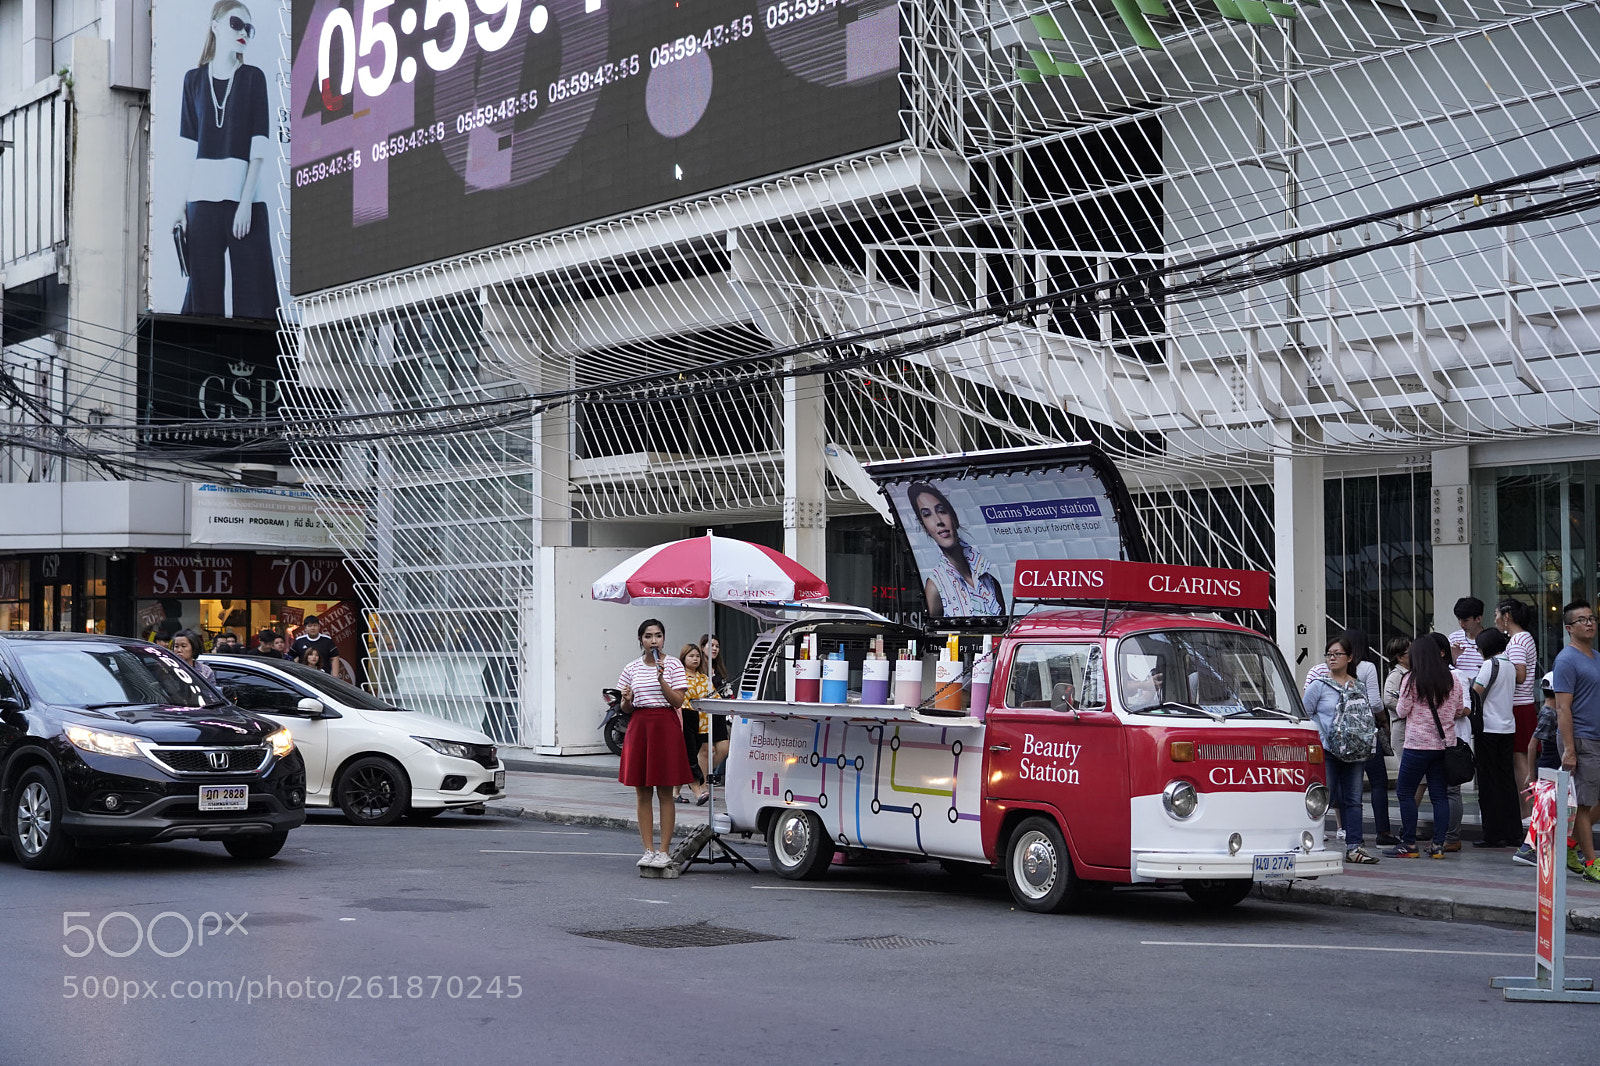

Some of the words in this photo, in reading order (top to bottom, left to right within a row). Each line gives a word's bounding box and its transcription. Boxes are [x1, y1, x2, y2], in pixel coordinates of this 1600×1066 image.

[198, 375, 282, 422] GSP
[985, 507, 1022, 520] Clarins
[1022, 504, 1058, 518] Beauty
[1058, 501, 1097, 515] station
[213, 516, 244, 524] ENGLISH
[249, 517, 285, 526] PROGRAM
[993, 526, 1013, 535] Meet
[1014, 526, 1023, 534] us
[1024, 525, 1032, 534] at
[1034, 525, 1049, 534] your
[1051, 521, 1081, 532] favorite
[1081, 520, 1102, 531] stop!
[42, 554, 60, 578] GSP
[154, 556, 233, 568] RENOVATION
[153, 569, 233, 595] SALE
[270, 559, 338, 596] 70%
[1019, 570, 1104, 587] CLARINS
[1148, 575, 1242, 596] CLARINS
[643, 586, 693, 595] CLARINS
[728, 588, 775, 598] CLARINS
[752, 734, 807, 748] #Beautystation
[1022, 733, 1082, 766] Beauty
[1019, 758, 1080, 785] Station
[1208, 767, 1306, 786] CLARINS
[223, 788, 245, 799] 2828
